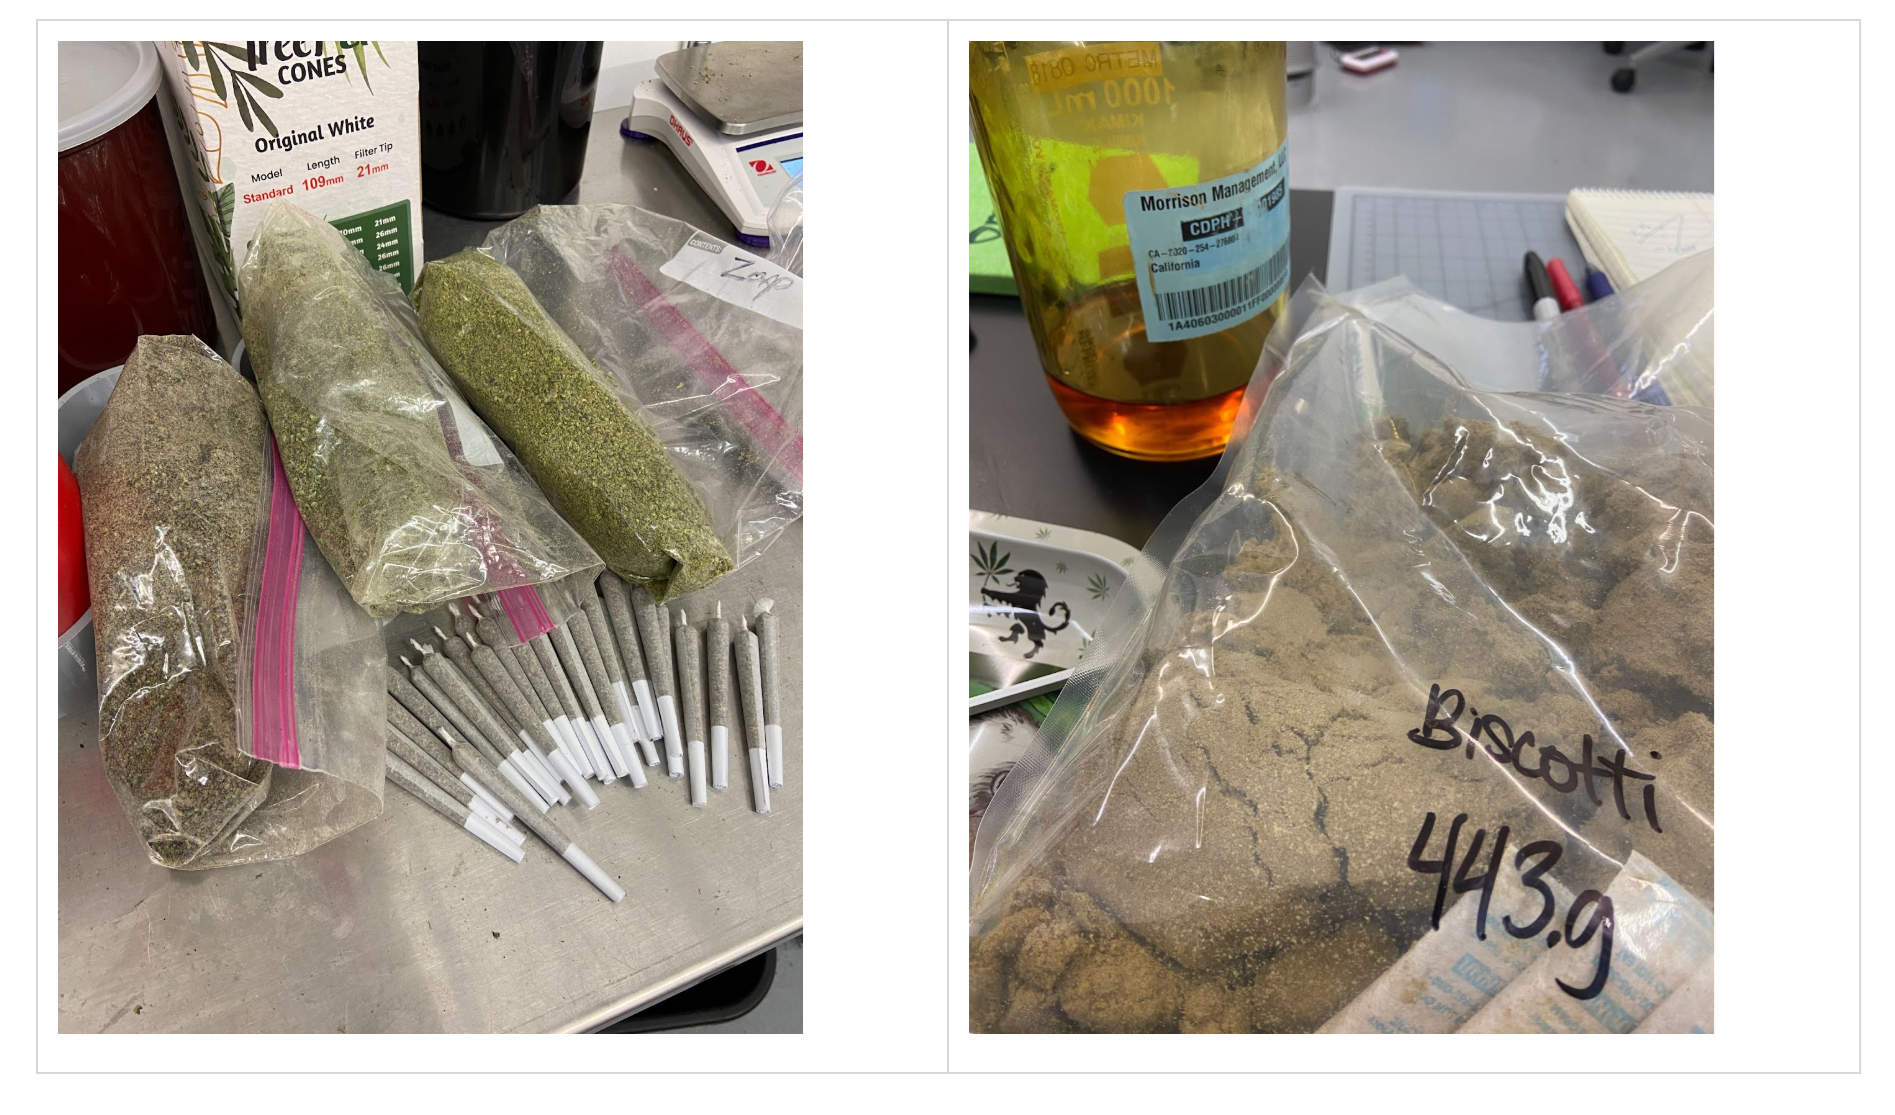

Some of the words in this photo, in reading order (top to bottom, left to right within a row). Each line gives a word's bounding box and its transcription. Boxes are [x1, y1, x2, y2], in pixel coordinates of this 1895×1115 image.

[278, 54, 347, 85] CONES
[255, 125, 324, 153] Original
[327, 115, 375, 138] White
[668, 114, 693, 147] OHAUS
[251, 168, 283, 183] Model
[307, 156, 341, 171] Length
[354, 147, 378, 159] Filter
[379, 142, 393, 153] Tip
[243, 184, 294, 204] Standard
[302, 174, 344, 191] 109mm
[356, 163, 389, 178] 21mm
[1140, 191, 1207, 212] Morrison
[1211, 163, 1278, 202] Management,
[374, 215, 396, 227] 21mm
[375, 227, 398, 239] 26mm
[376, 238, 399, 250] 24mm
[377, 249, 400, 261] 26mm
[689, 239, 722, 252] CONTENTS:
[1150, 258, 1201, 274] California
[1407, 683, 1663, 833] Biscotti
